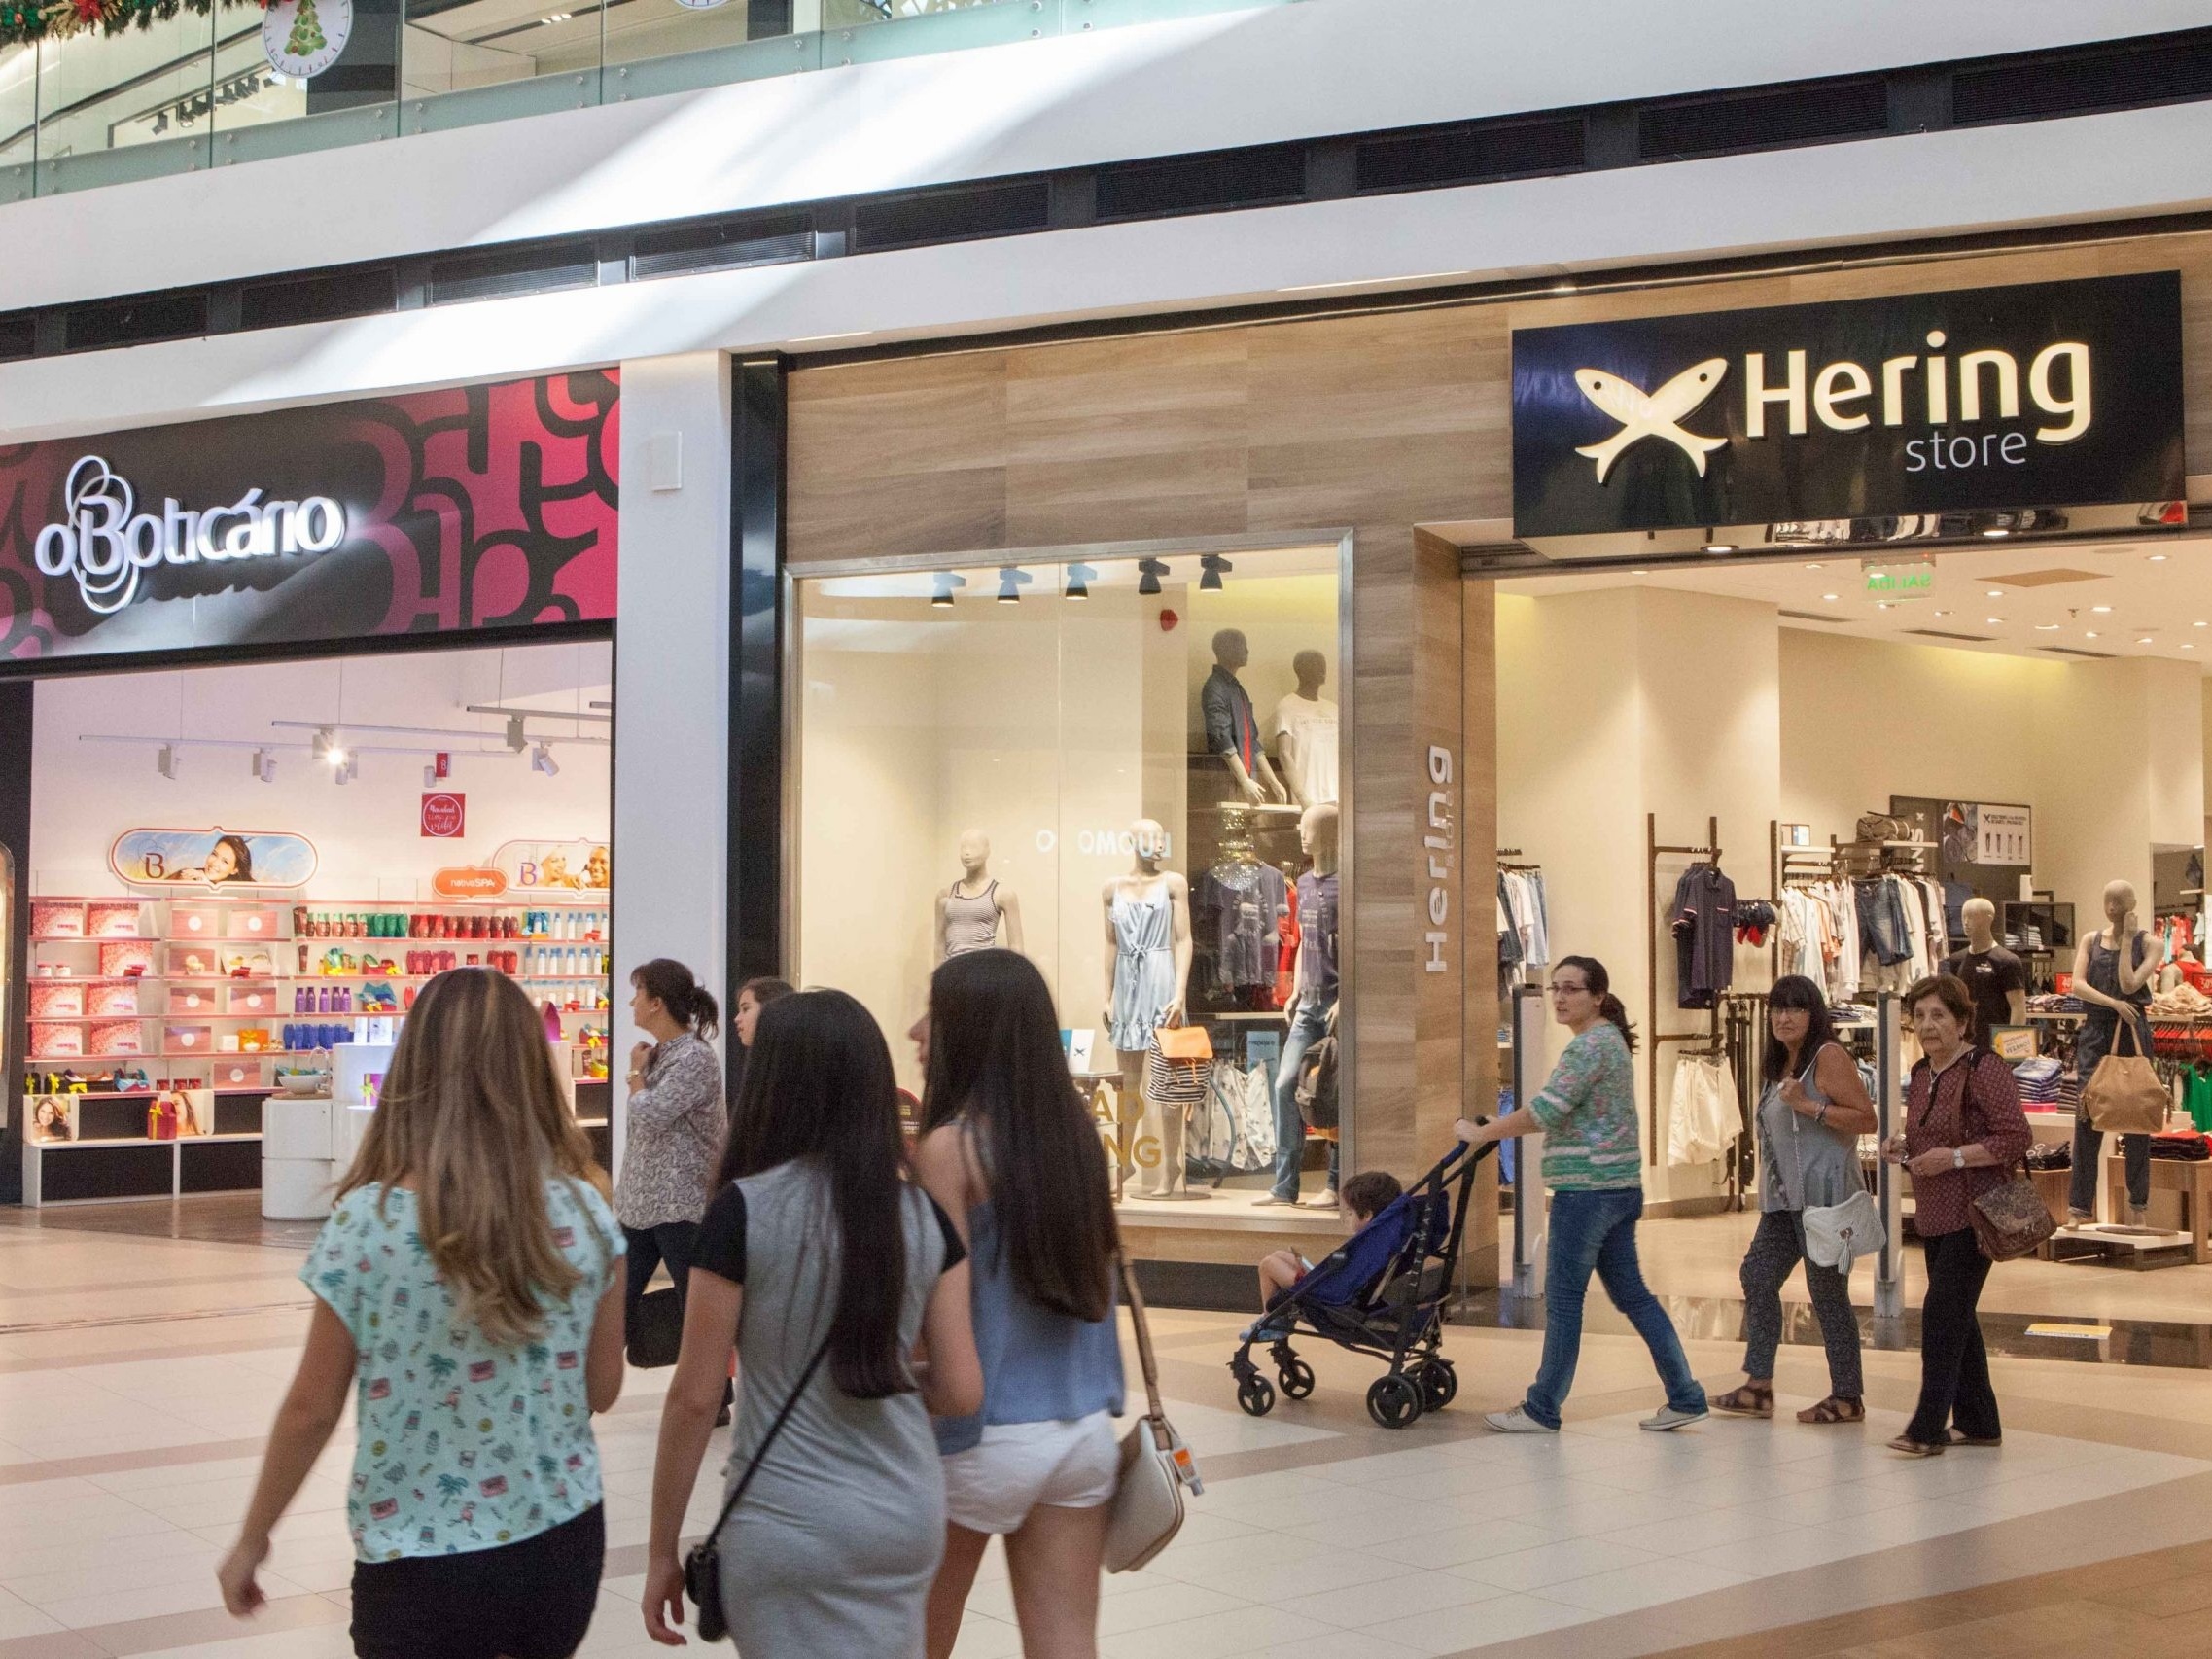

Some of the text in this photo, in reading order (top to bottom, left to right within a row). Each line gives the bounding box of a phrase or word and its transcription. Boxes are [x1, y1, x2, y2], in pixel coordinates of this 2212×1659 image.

[1745, 331, 2092, 443] Hering
[1906, 430, 2028, 473] store
[1424, 745, 1453, 971] Hering
